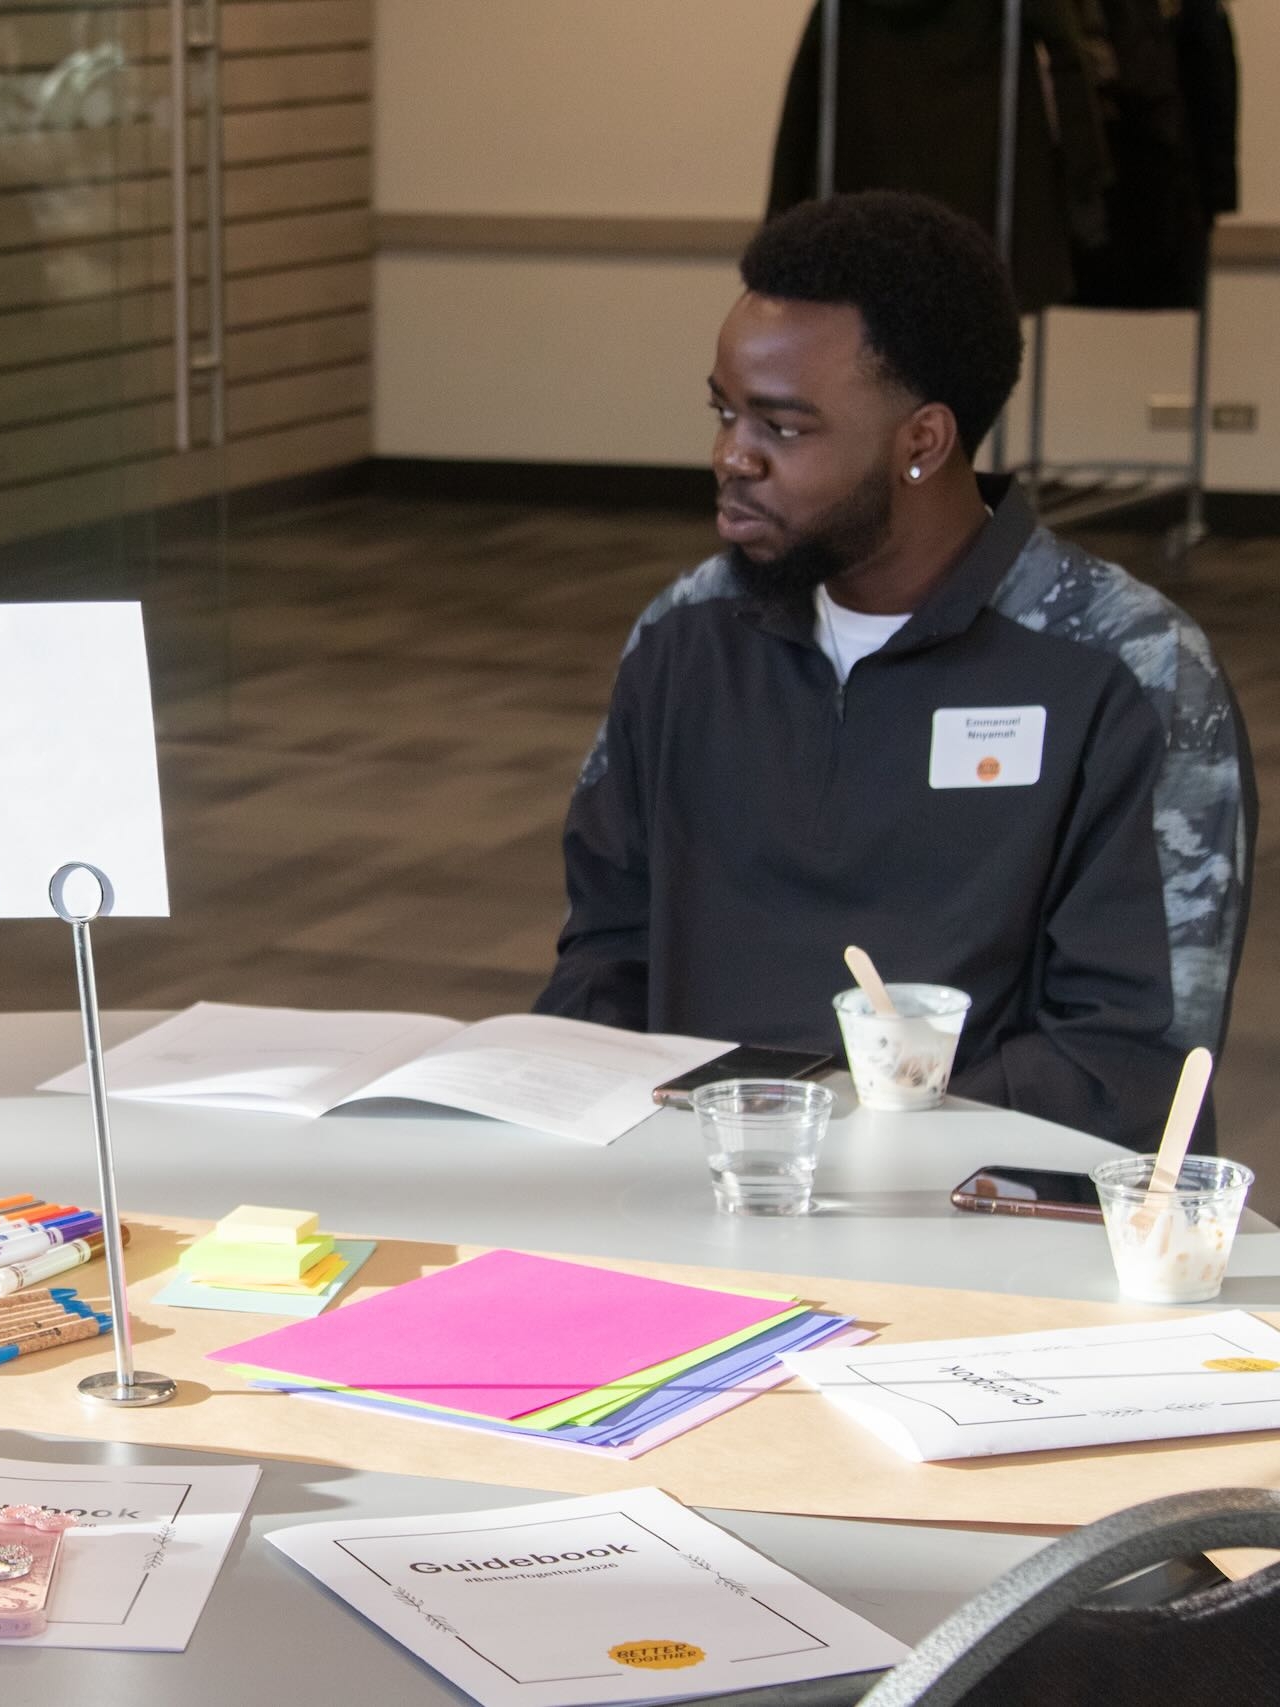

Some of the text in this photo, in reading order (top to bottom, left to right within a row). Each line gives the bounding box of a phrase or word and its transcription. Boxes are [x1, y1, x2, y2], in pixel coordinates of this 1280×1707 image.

[966, 717, 1021, 727] Emmanuel
[408, 1543, 639, 1575] Guidebook
[464, 1562, 620, 1584] #BetterTogether2026
[617, 1642, 688, 1659] BETTER
[624, 1650, 698, 1665] TOGETHER
